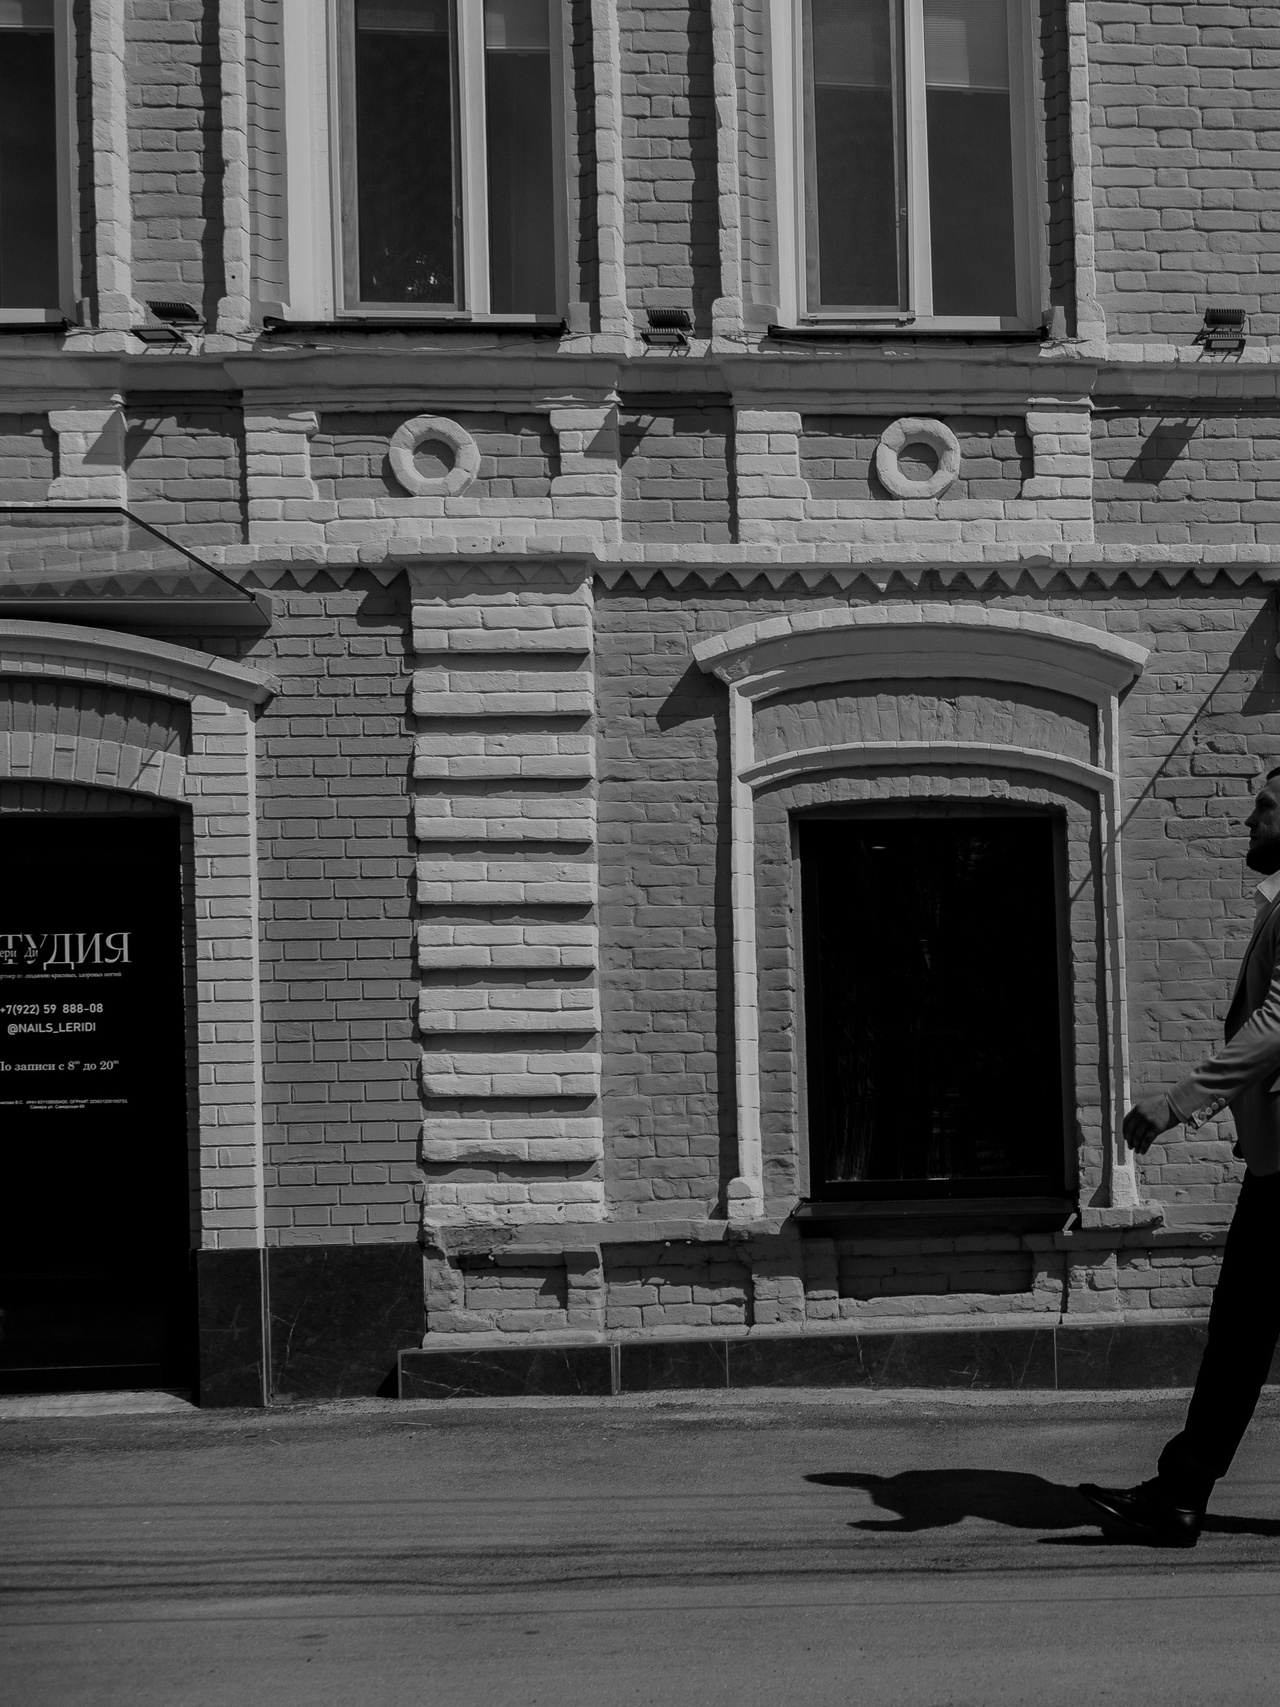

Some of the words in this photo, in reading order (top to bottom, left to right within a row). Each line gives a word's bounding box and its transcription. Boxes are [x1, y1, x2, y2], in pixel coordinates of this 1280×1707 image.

[0, 931, 132, 970] ТУДИЯ
[0, 949, 17, 961] ери
[0, 1004, 40, 1016] +7(922)
[43, 1004, 57, 1014] 59
[62, 1003, 104, 1014] 888-08
[7, 1022, 96, 1036] @NAILS_LERIDI
[14, 1063, 56, 1071] записи
[58, 1063, 65, 1071] с
[82, 1063, 97, 1071] до
